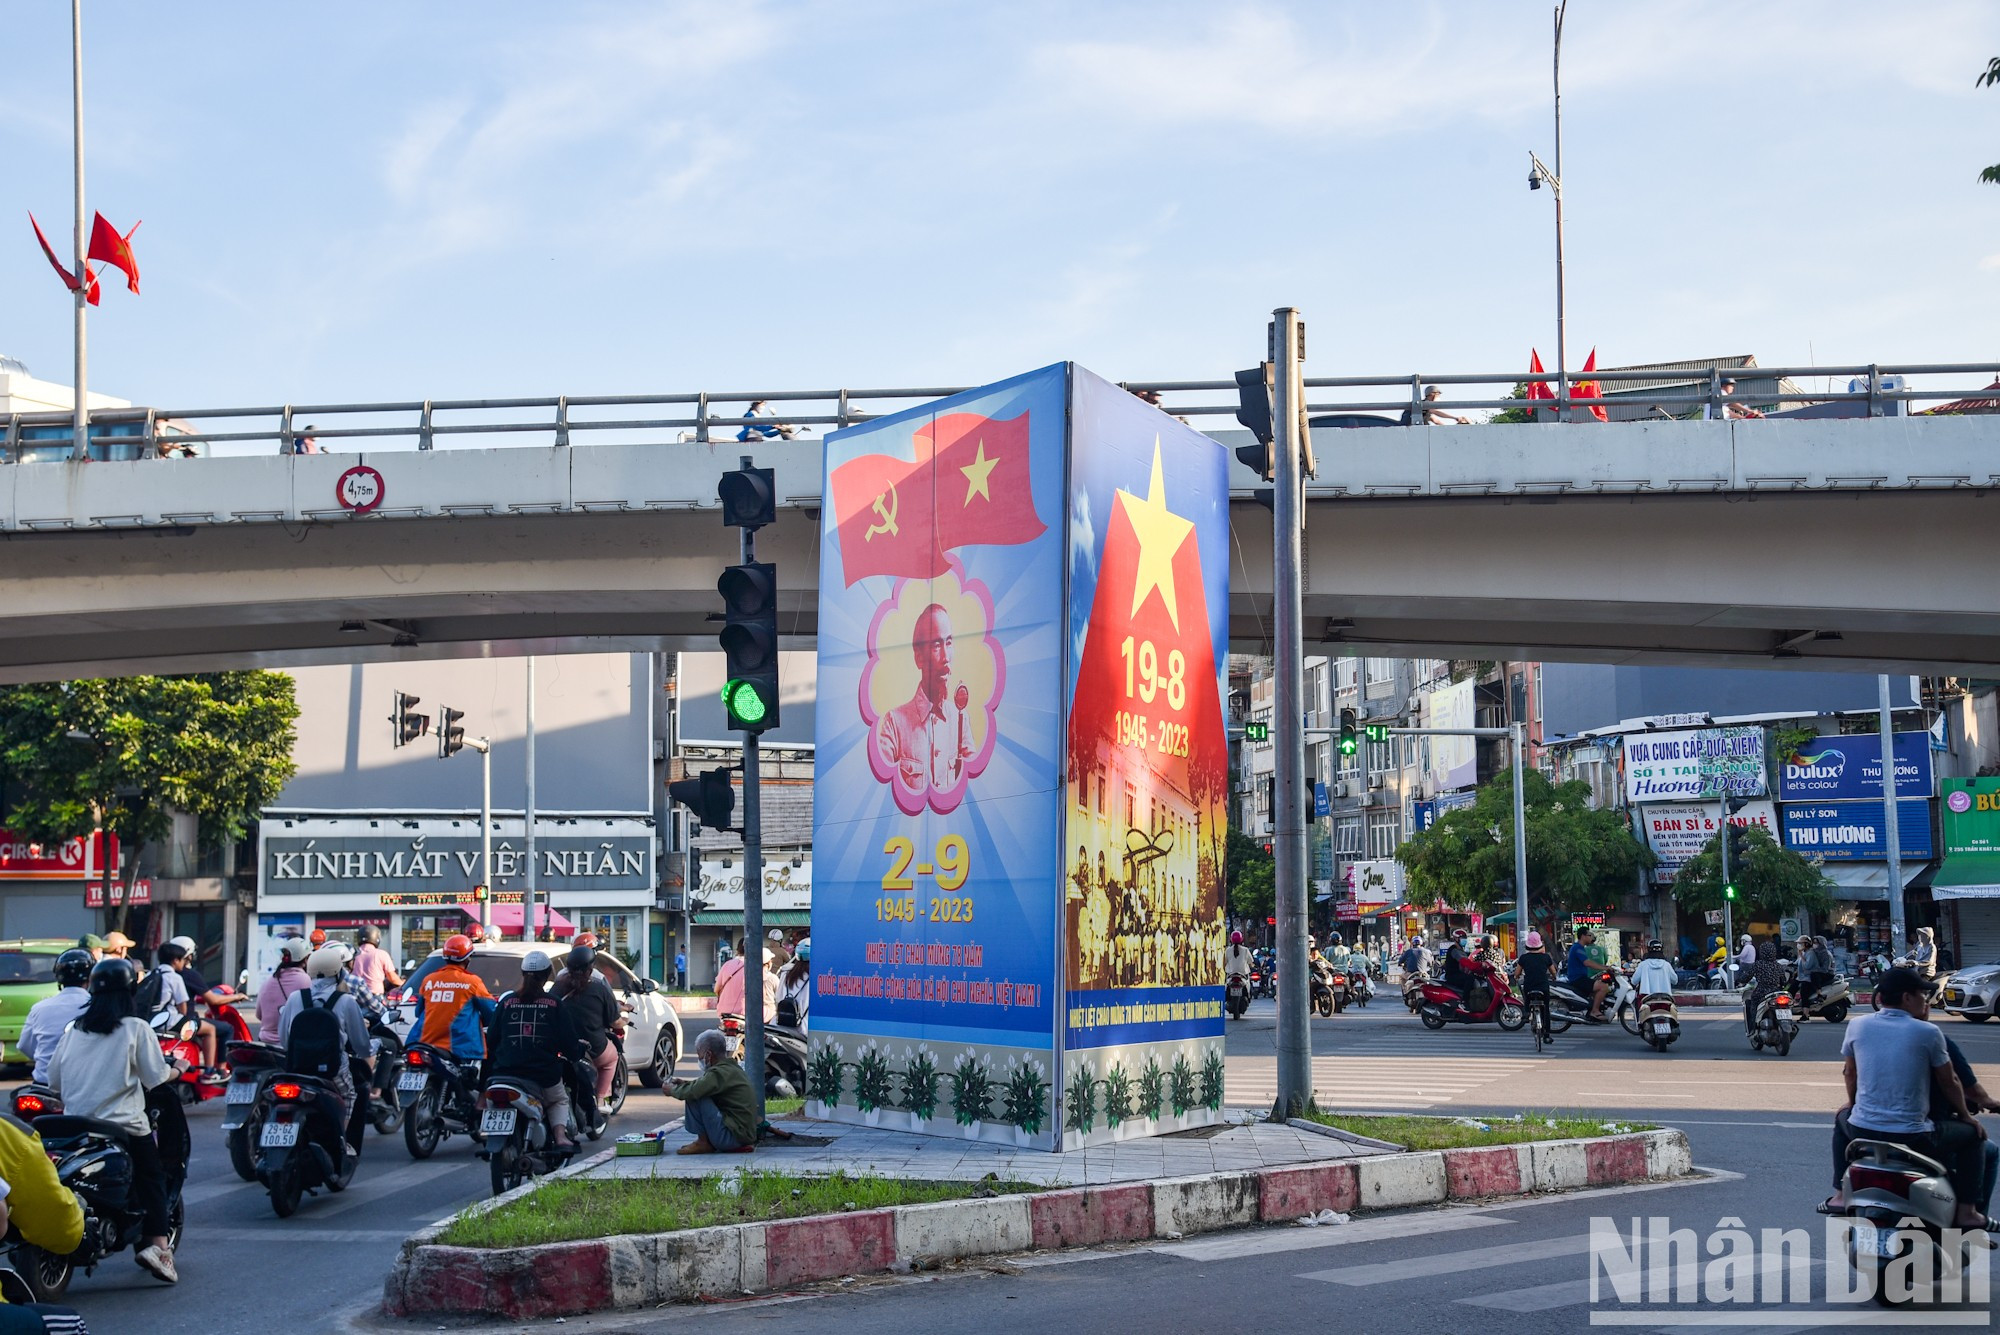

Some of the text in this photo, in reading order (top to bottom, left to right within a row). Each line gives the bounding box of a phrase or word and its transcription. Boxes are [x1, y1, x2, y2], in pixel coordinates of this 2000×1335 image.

[348, 480, 373, 498] 4,75m
[1122, 635, 1185, 711] 19-8
[1116, 711, 1147, 749] 1945
[1158, 720, 1188, 757] 2023
[1248, 727, 1265, 738] 41
[1366, 727, 1387, 740] 41
[1630, 743, 1650, 765] VỰA
[1652, 741, 1680, 761] CUNG
[1683, 734, 1703, 759] CẤP
[1634, 766, 1653, 778] SỐ
[1659, 768, 1666, 776] 1
[1786, 764, 1839, 780] Dulux
[1862, 768, 1881, 776] THU
[1634, 779, 1705, 795] Hương
[1787, 781, 1839, 790] let's colour
[1653, 818, 1682, 832] BÁN
[1685, 814, 1700, 830] SỈ
[1704, 818, 1714, 830] &
[1789, 808, 1838, 820] ĐẠI LÝ SƠN
[1789, 826, 1876, 844] THU HƯƠNG
[273, 840, 368, 879] KÍNH
[373, 834, 448, 878] MẮT
[544, 842, 646, 876] NHÃN
[882, 834, 970, 891] 2-9
[876, 898, 914, 922] 1945
[930, 898, 973, 922] 2023
[866, 938, 983, 969] NHIỆT LIỆT CHÀO MỪNG 78 NĂM
[818, 967, 836, 997] QUỐC
[838, 971, 862, 997] KHÁNH
[864, 970, 884, 998] NƯỚC
[885, 973, 905, 1004] CỘNG
[923, 975, 934, 1001] XÃ
[936, 975, 950, 1007] HỘI
[951, 972, 968, 1004] CHỦ
[969, 977, 994, 1005] NGHĨA
[996, 978, 1014, 1011] VIỆT
[1015, 983, 1035, 1007] NAM
[264, 1135, 294, 1145] 100.50
